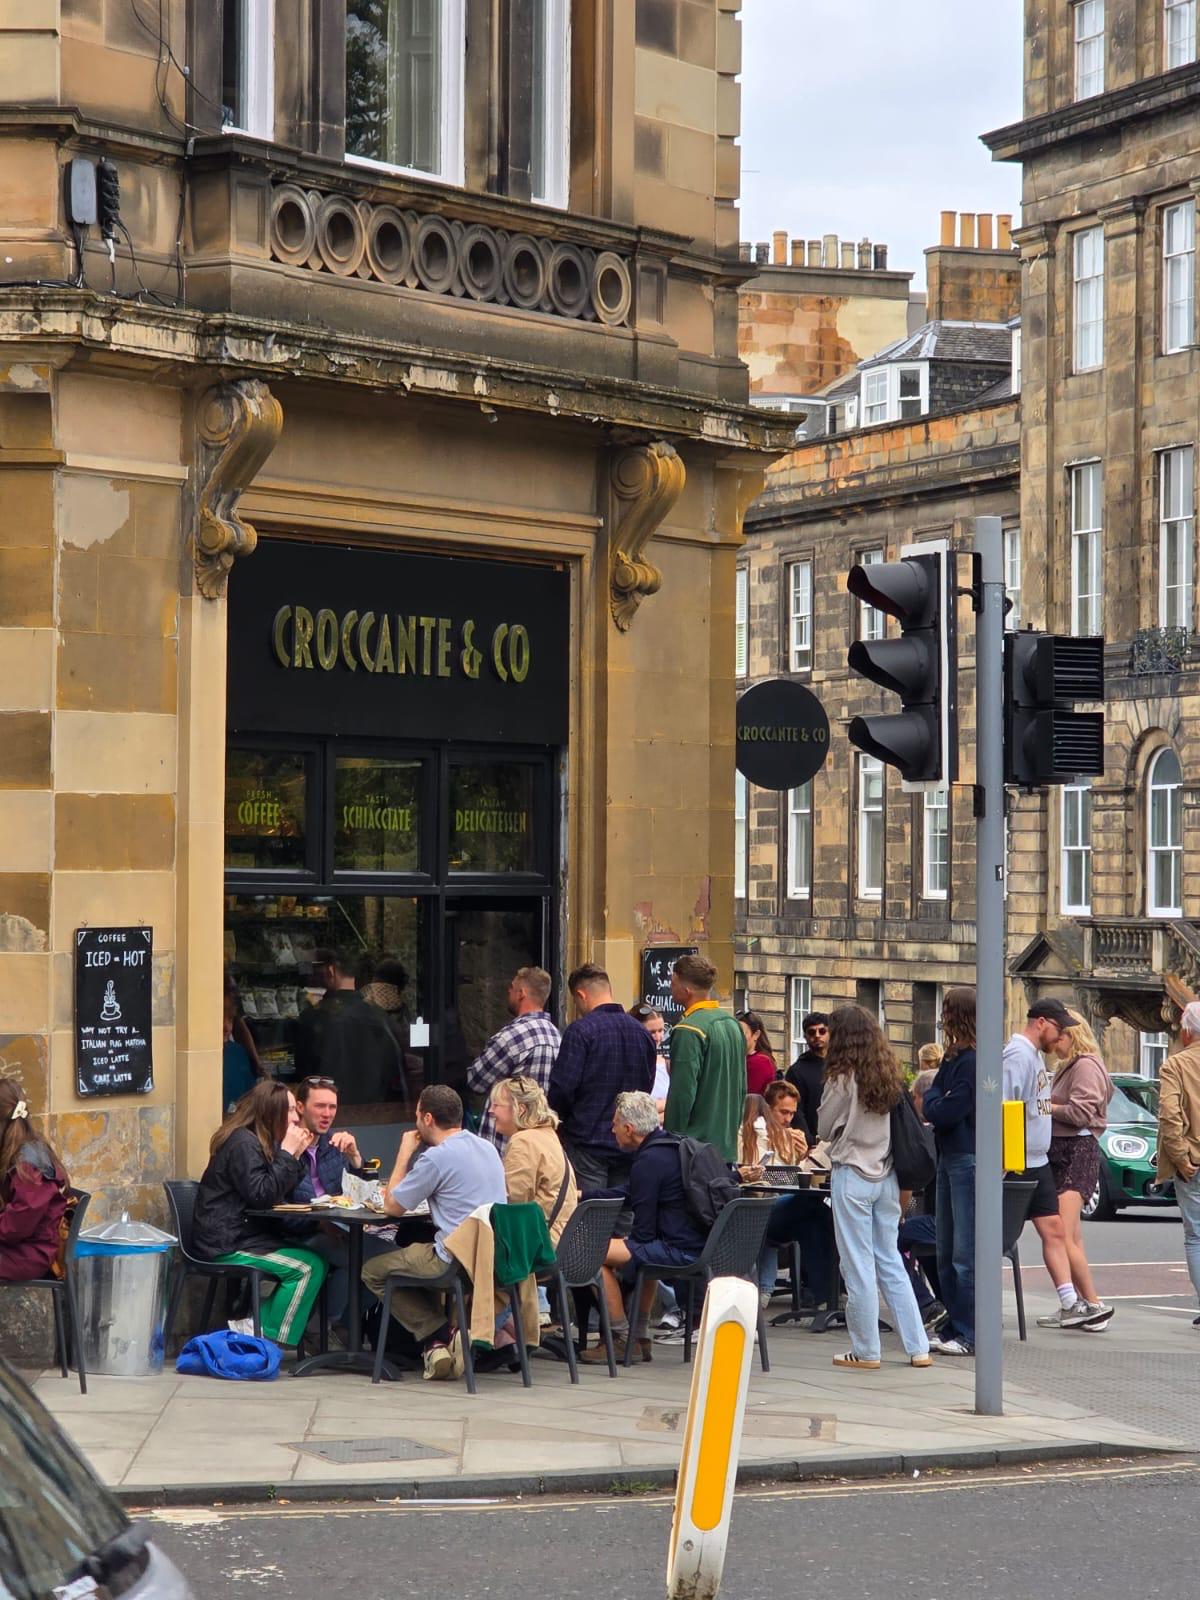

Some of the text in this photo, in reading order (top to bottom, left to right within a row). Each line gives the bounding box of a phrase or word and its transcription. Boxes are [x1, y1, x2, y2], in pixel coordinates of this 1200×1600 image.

[271, 604, 530, 683] CROCCANTE & CO
[737, 726, 826, 742] CROCCANTE & CO
[246, 790, 272, 799] FRESH
[238, 801, 280, 826] COFFEE
[343, 805, 410, 831] SCHIACCIATE
[455, 809, 527, 832] DELICATESSEN
[98, 933, 127, 943] COFFEE
[85, 951, 111, 967] ICED
[123, 950, 146, 967] HOT
[650, 962, 662, 976] WE
[115, 1026, 128, 1034] TRY
[81, 1039, 106, 1049] ITALIAN
[92, 1054, 130, 1066] ICED LATTE
[113, 1072, 132, 1083] LATTE
